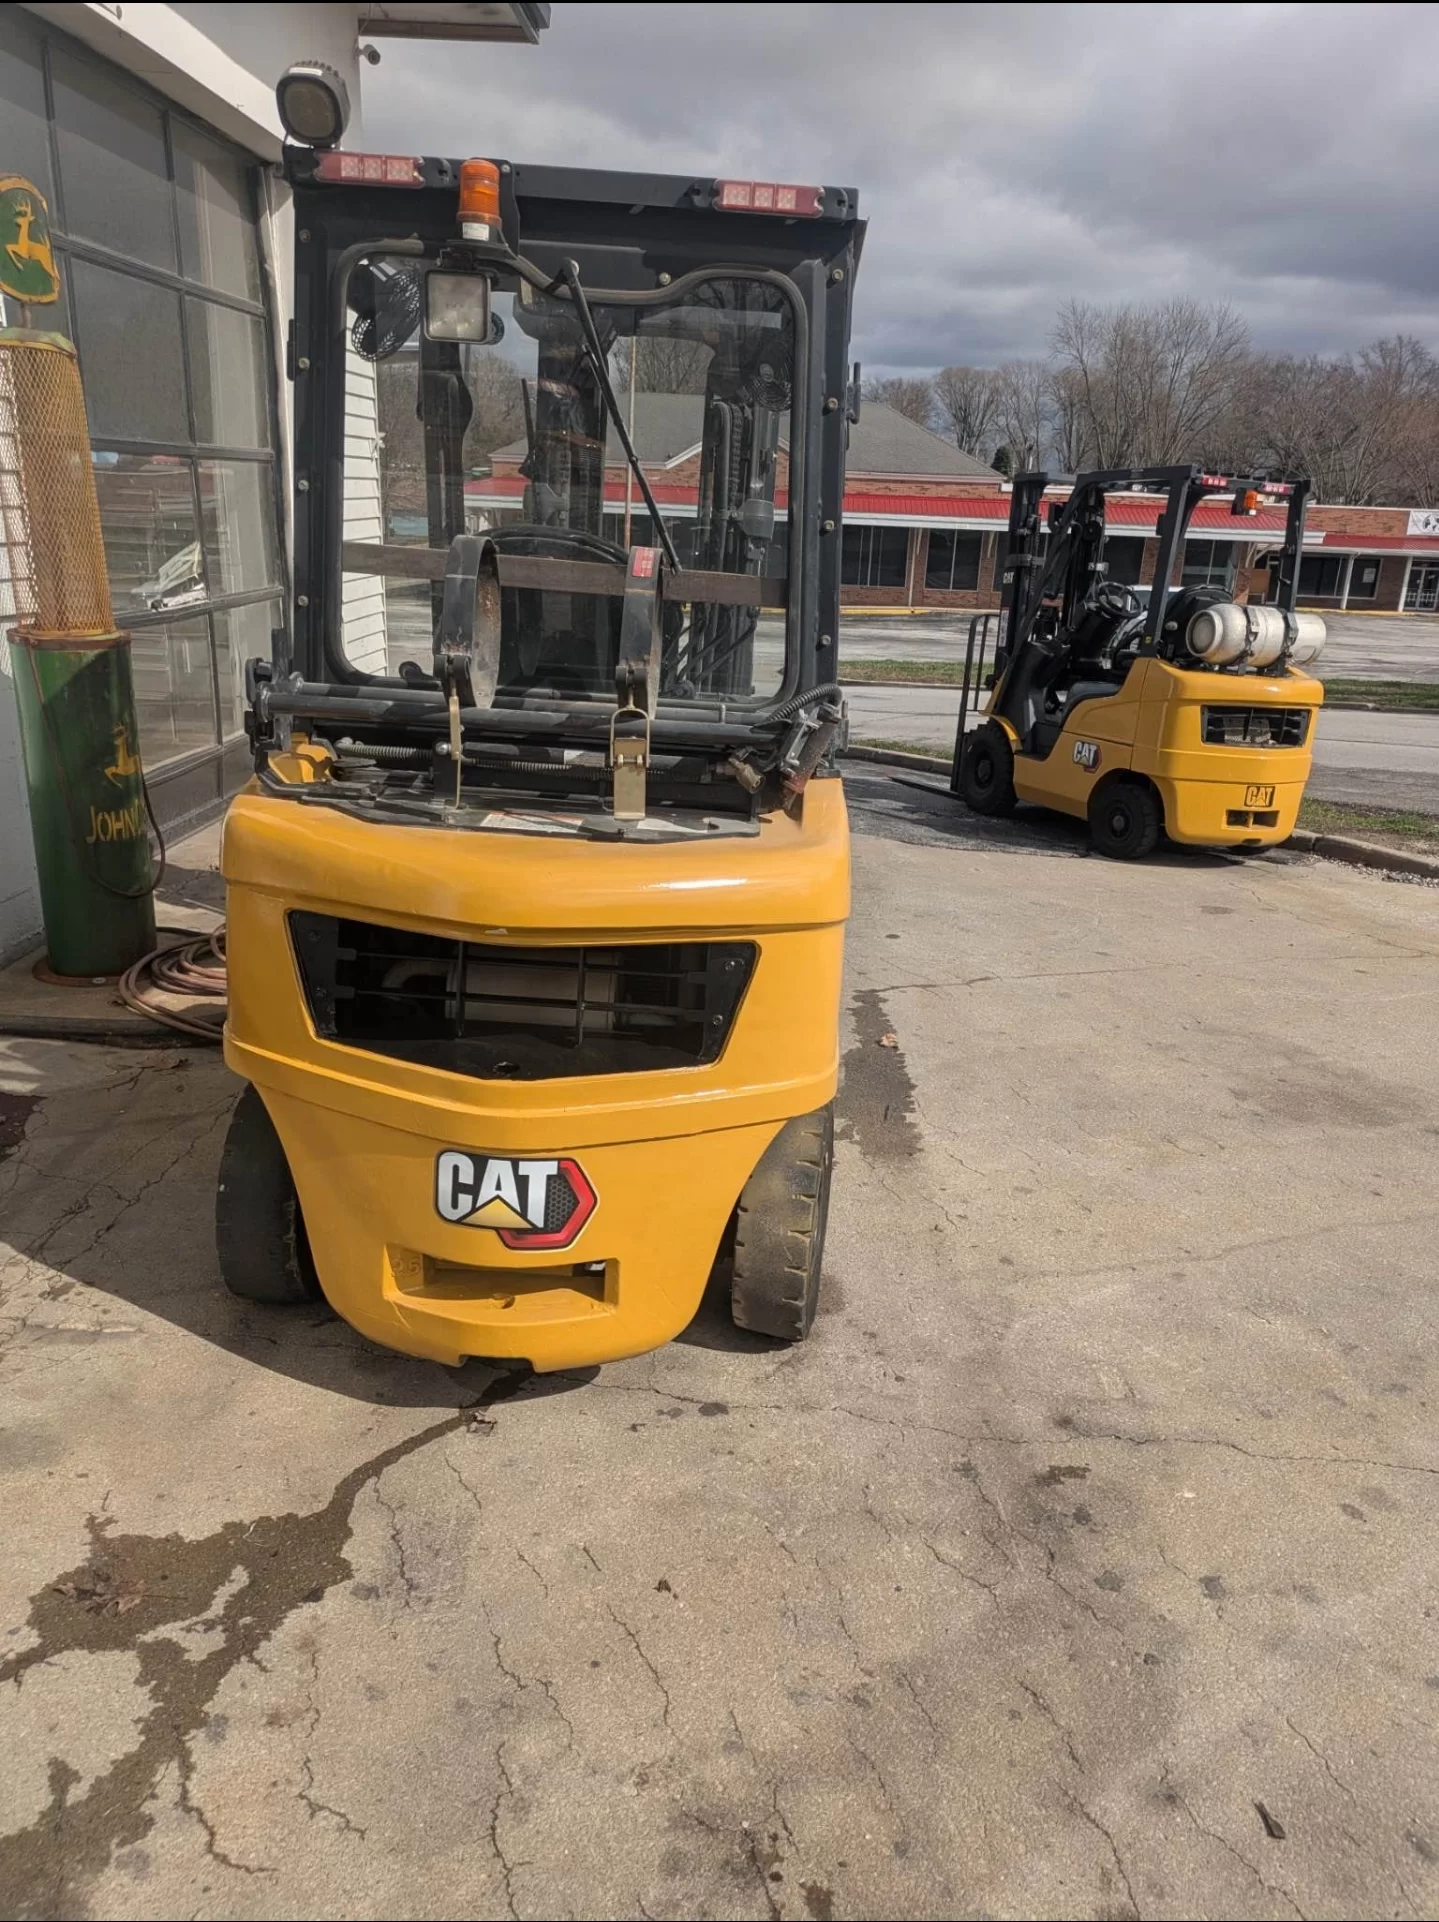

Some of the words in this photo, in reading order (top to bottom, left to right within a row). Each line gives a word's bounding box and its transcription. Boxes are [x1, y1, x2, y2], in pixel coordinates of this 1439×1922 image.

[1073, 741, 1097, 766] CAT
[1246, 786, 1273, 806] CAT
[86, 805, 135, 844] JOHN
[437, 1151, 558, 1229] CAT
